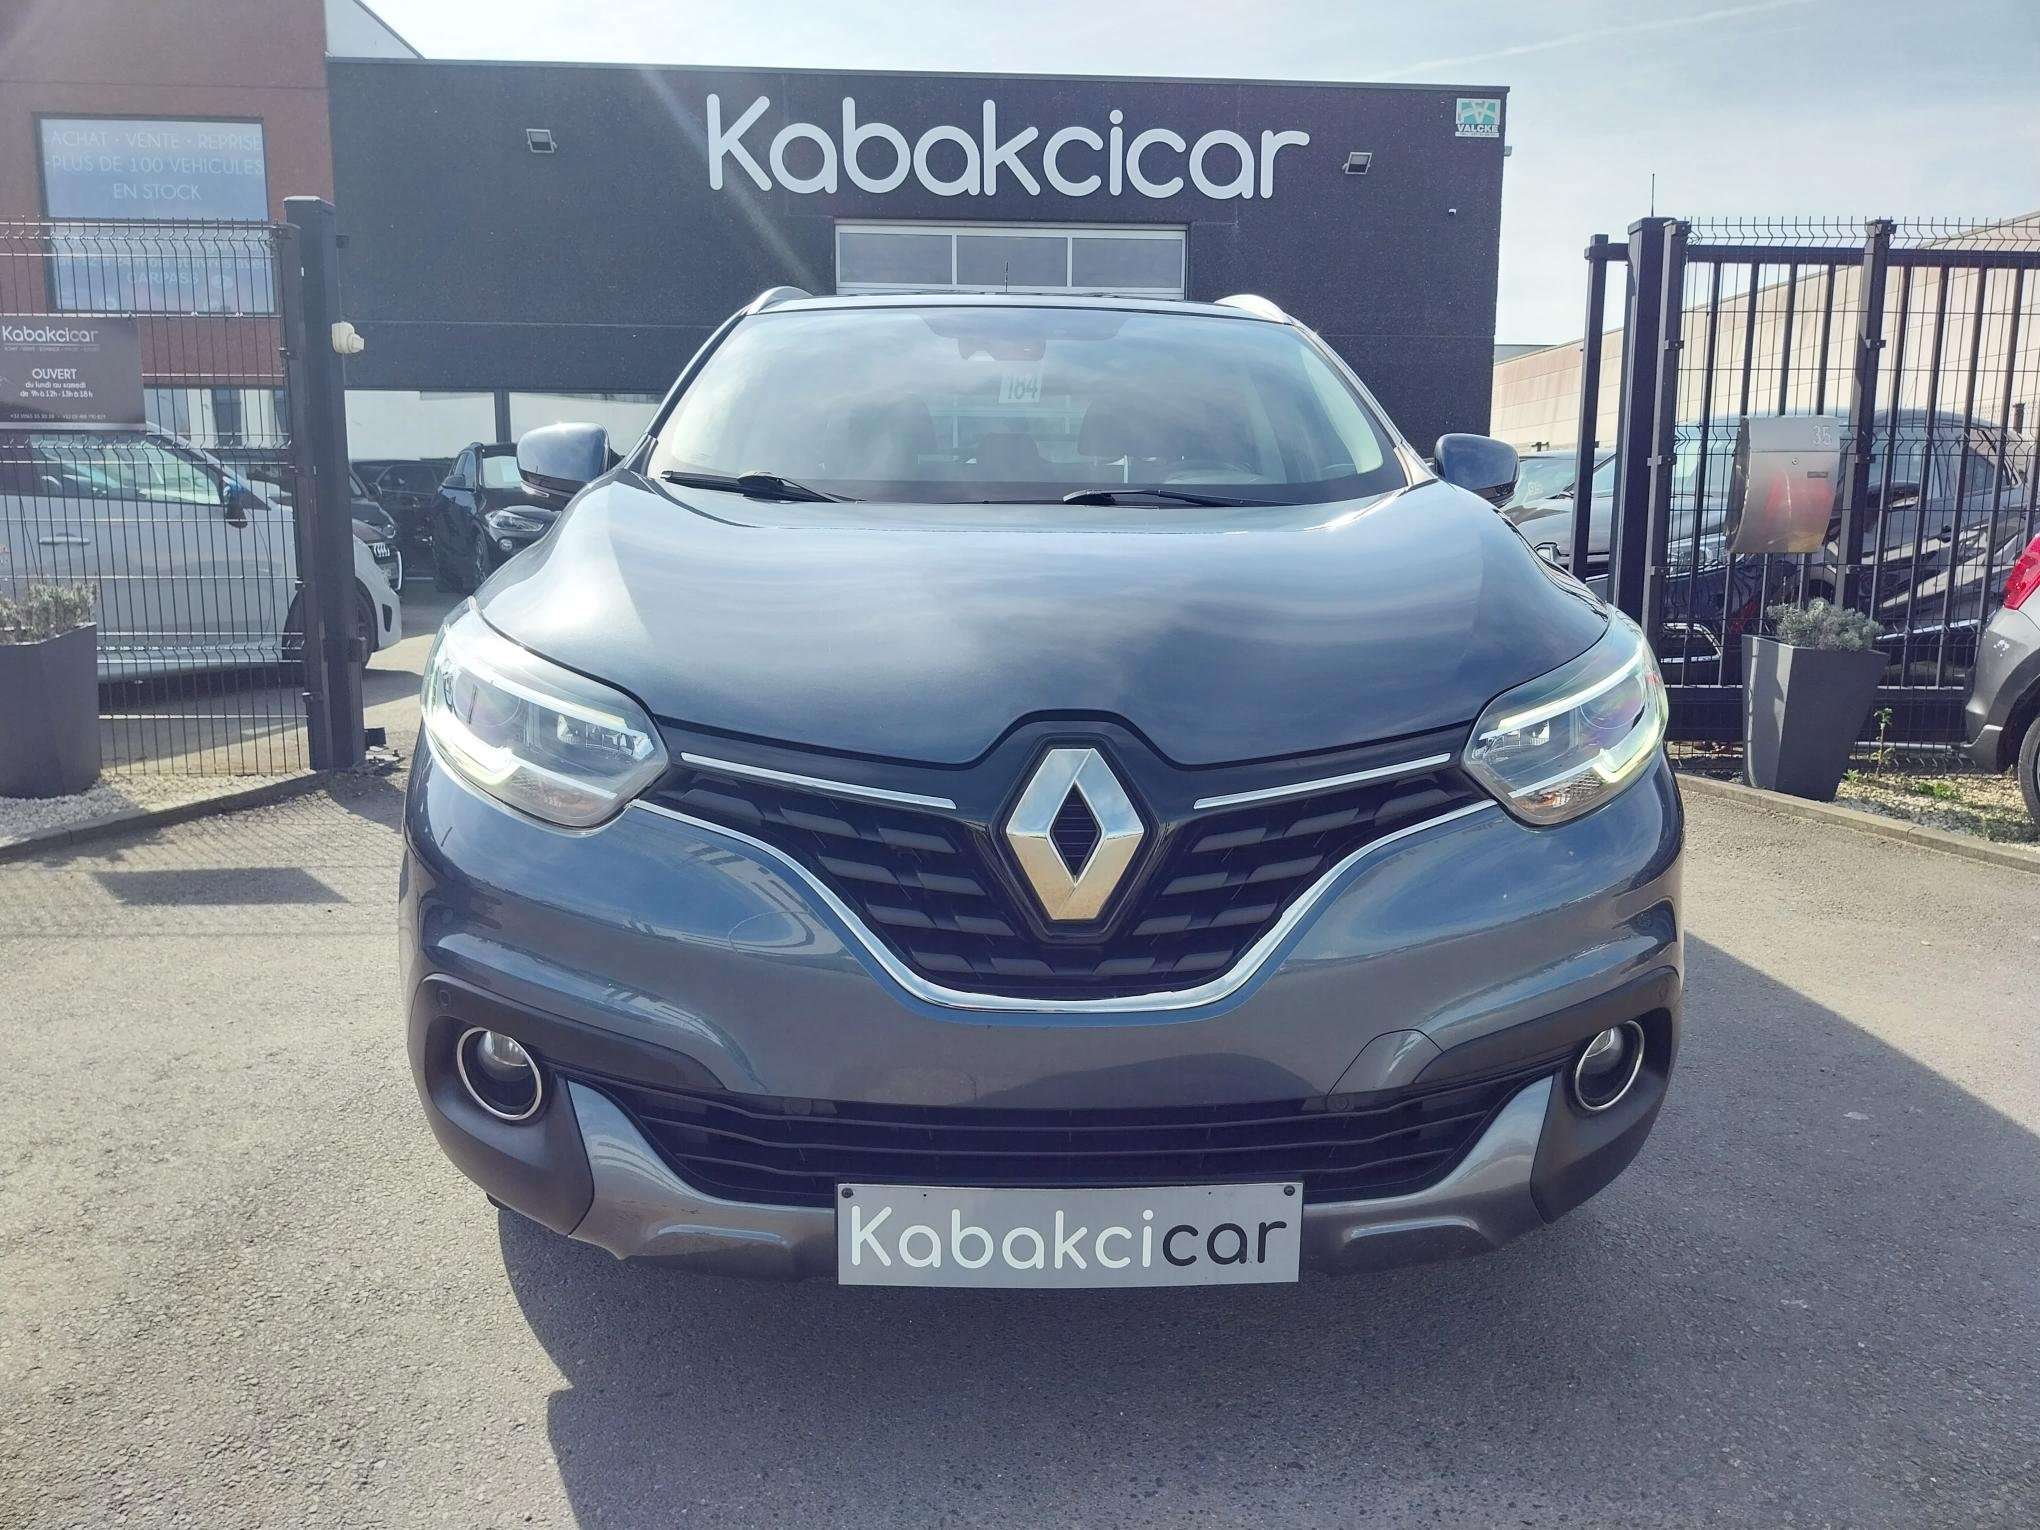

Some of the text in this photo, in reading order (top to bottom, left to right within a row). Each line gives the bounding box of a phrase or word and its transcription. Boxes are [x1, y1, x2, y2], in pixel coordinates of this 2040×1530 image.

[1457, 124, 1499, 133] VALCKE
[51, 130, 109, 147] ACHAT
[126, 132, 180, 150] VENTE
[707, 93, 1310, 199] Kabakcicar
[51, 155, 93, 173] PLUS
[99, 157, 121, 173] DE
[128, 158, 164, 174] 100
[113, 183, 202, 201] EN STOCK
[1, 325, 99, 342] Kabakcicar
[32, 368, 77, 380] OUVERT
[1811, 425, 1833, 446] 35
[850, 1205, 1287, 1270] Kabakcicar
